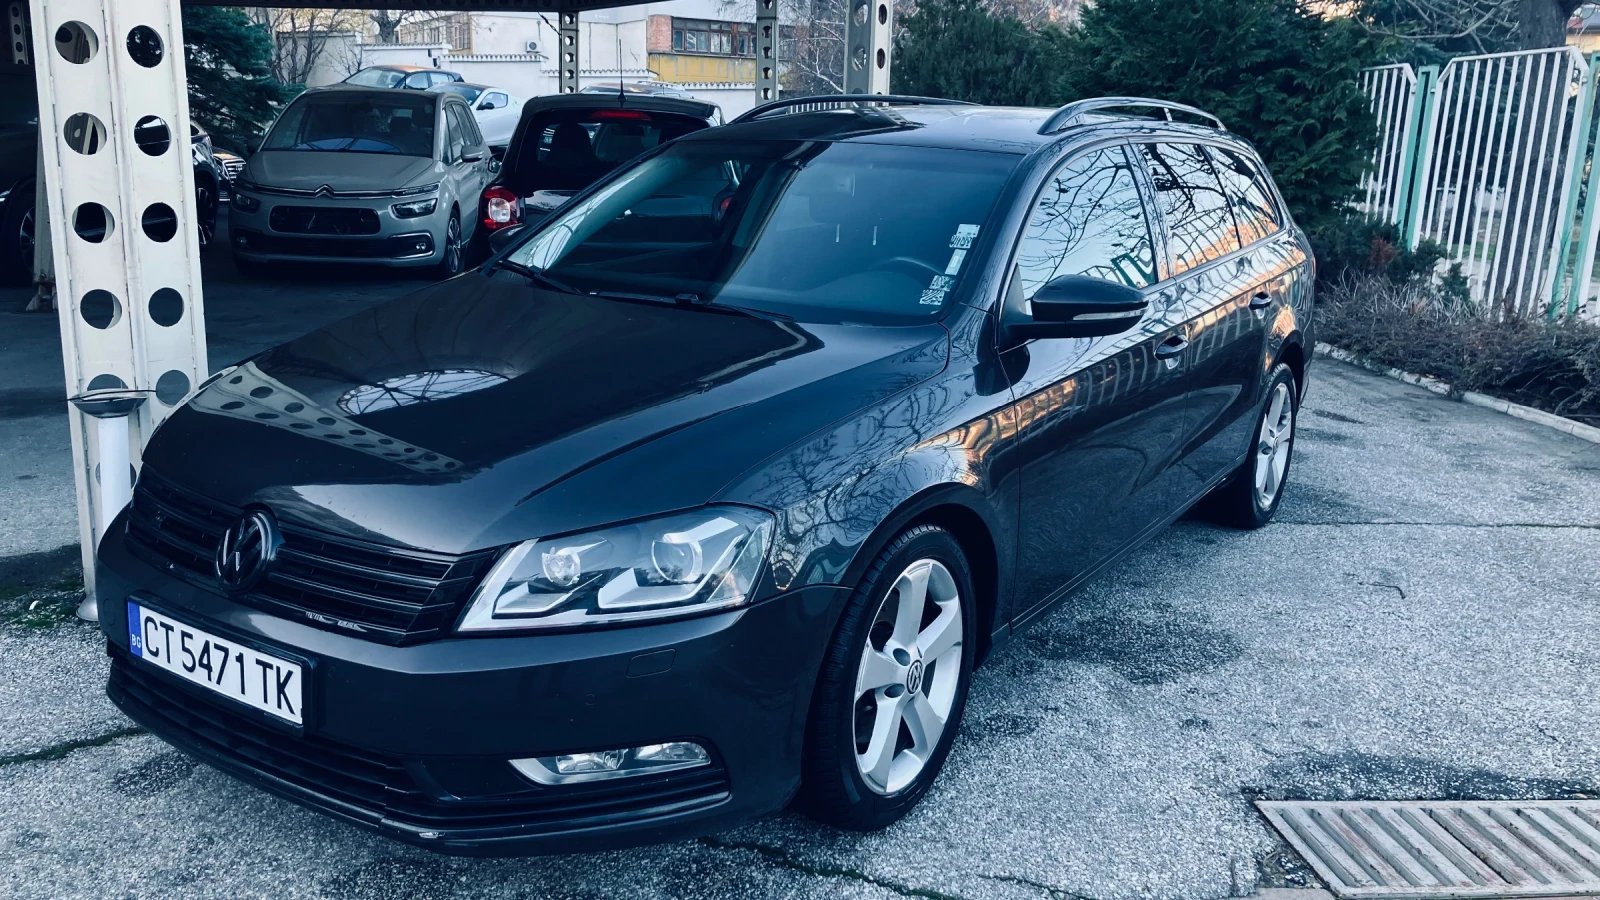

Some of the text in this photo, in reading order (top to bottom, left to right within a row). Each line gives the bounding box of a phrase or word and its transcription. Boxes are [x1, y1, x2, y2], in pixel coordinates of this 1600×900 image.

[132, 634, 142, 648] BG
[144, 615, 295, 715] CT 5471 TK
